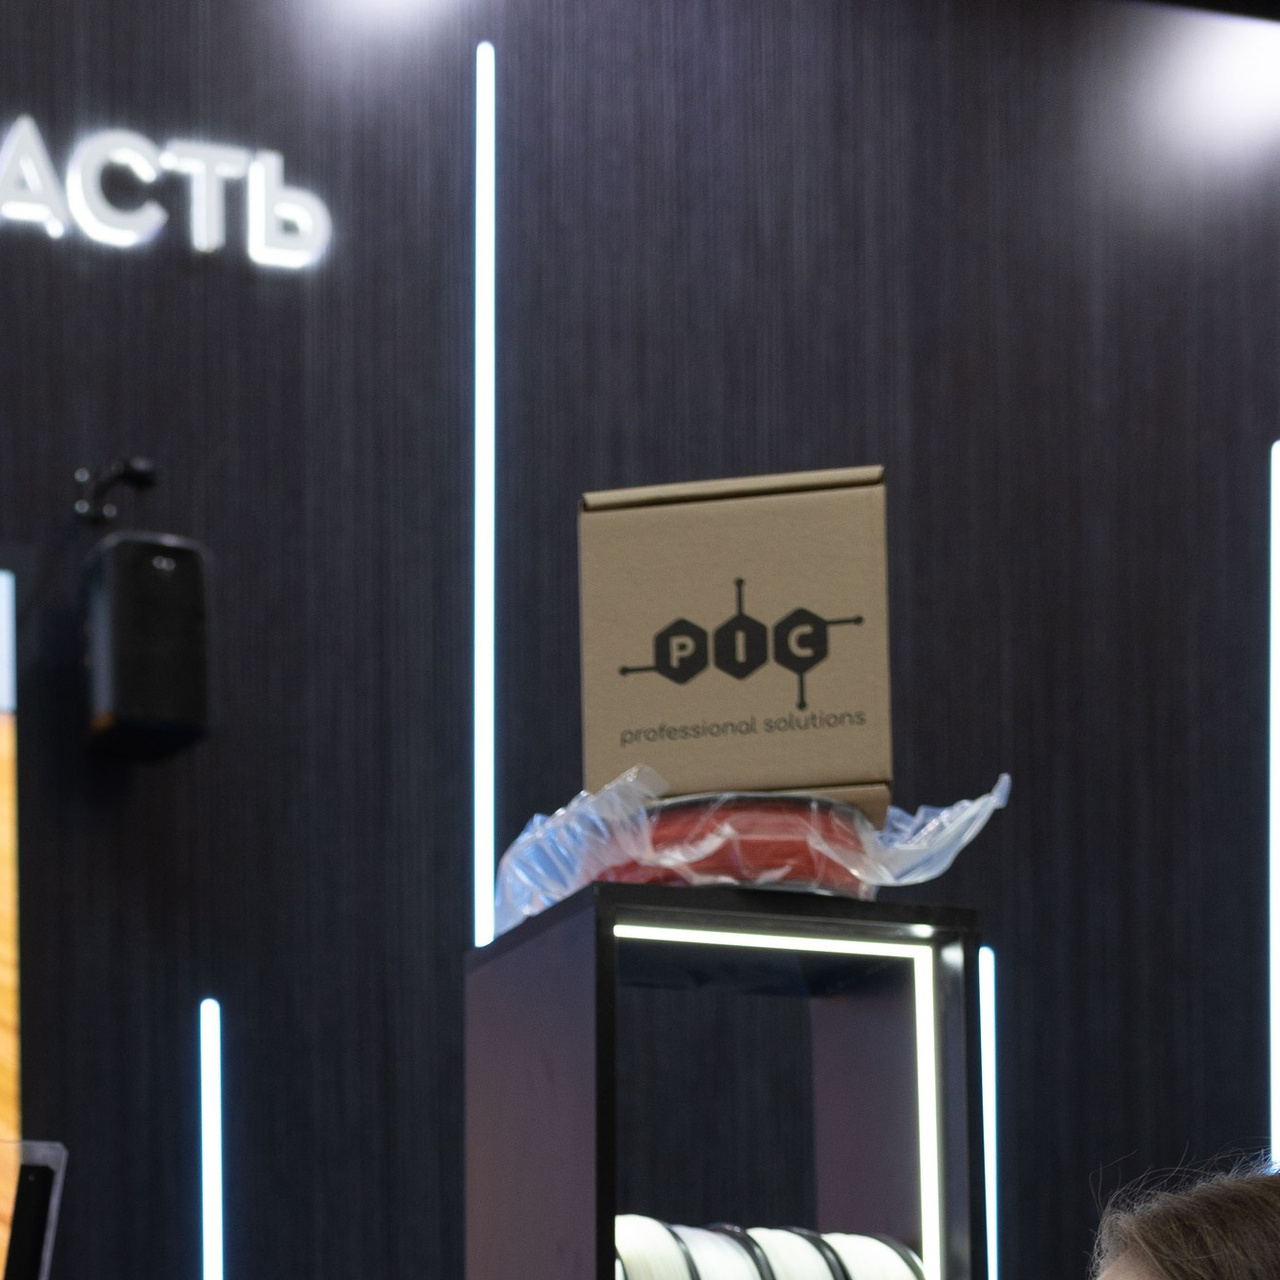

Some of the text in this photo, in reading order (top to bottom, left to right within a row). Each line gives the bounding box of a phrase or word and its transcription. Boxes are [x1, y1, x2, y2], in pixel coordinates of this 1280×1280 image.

[663, 617, 821, 674] PIC
[620, 709, 867, 748] professional solutions
